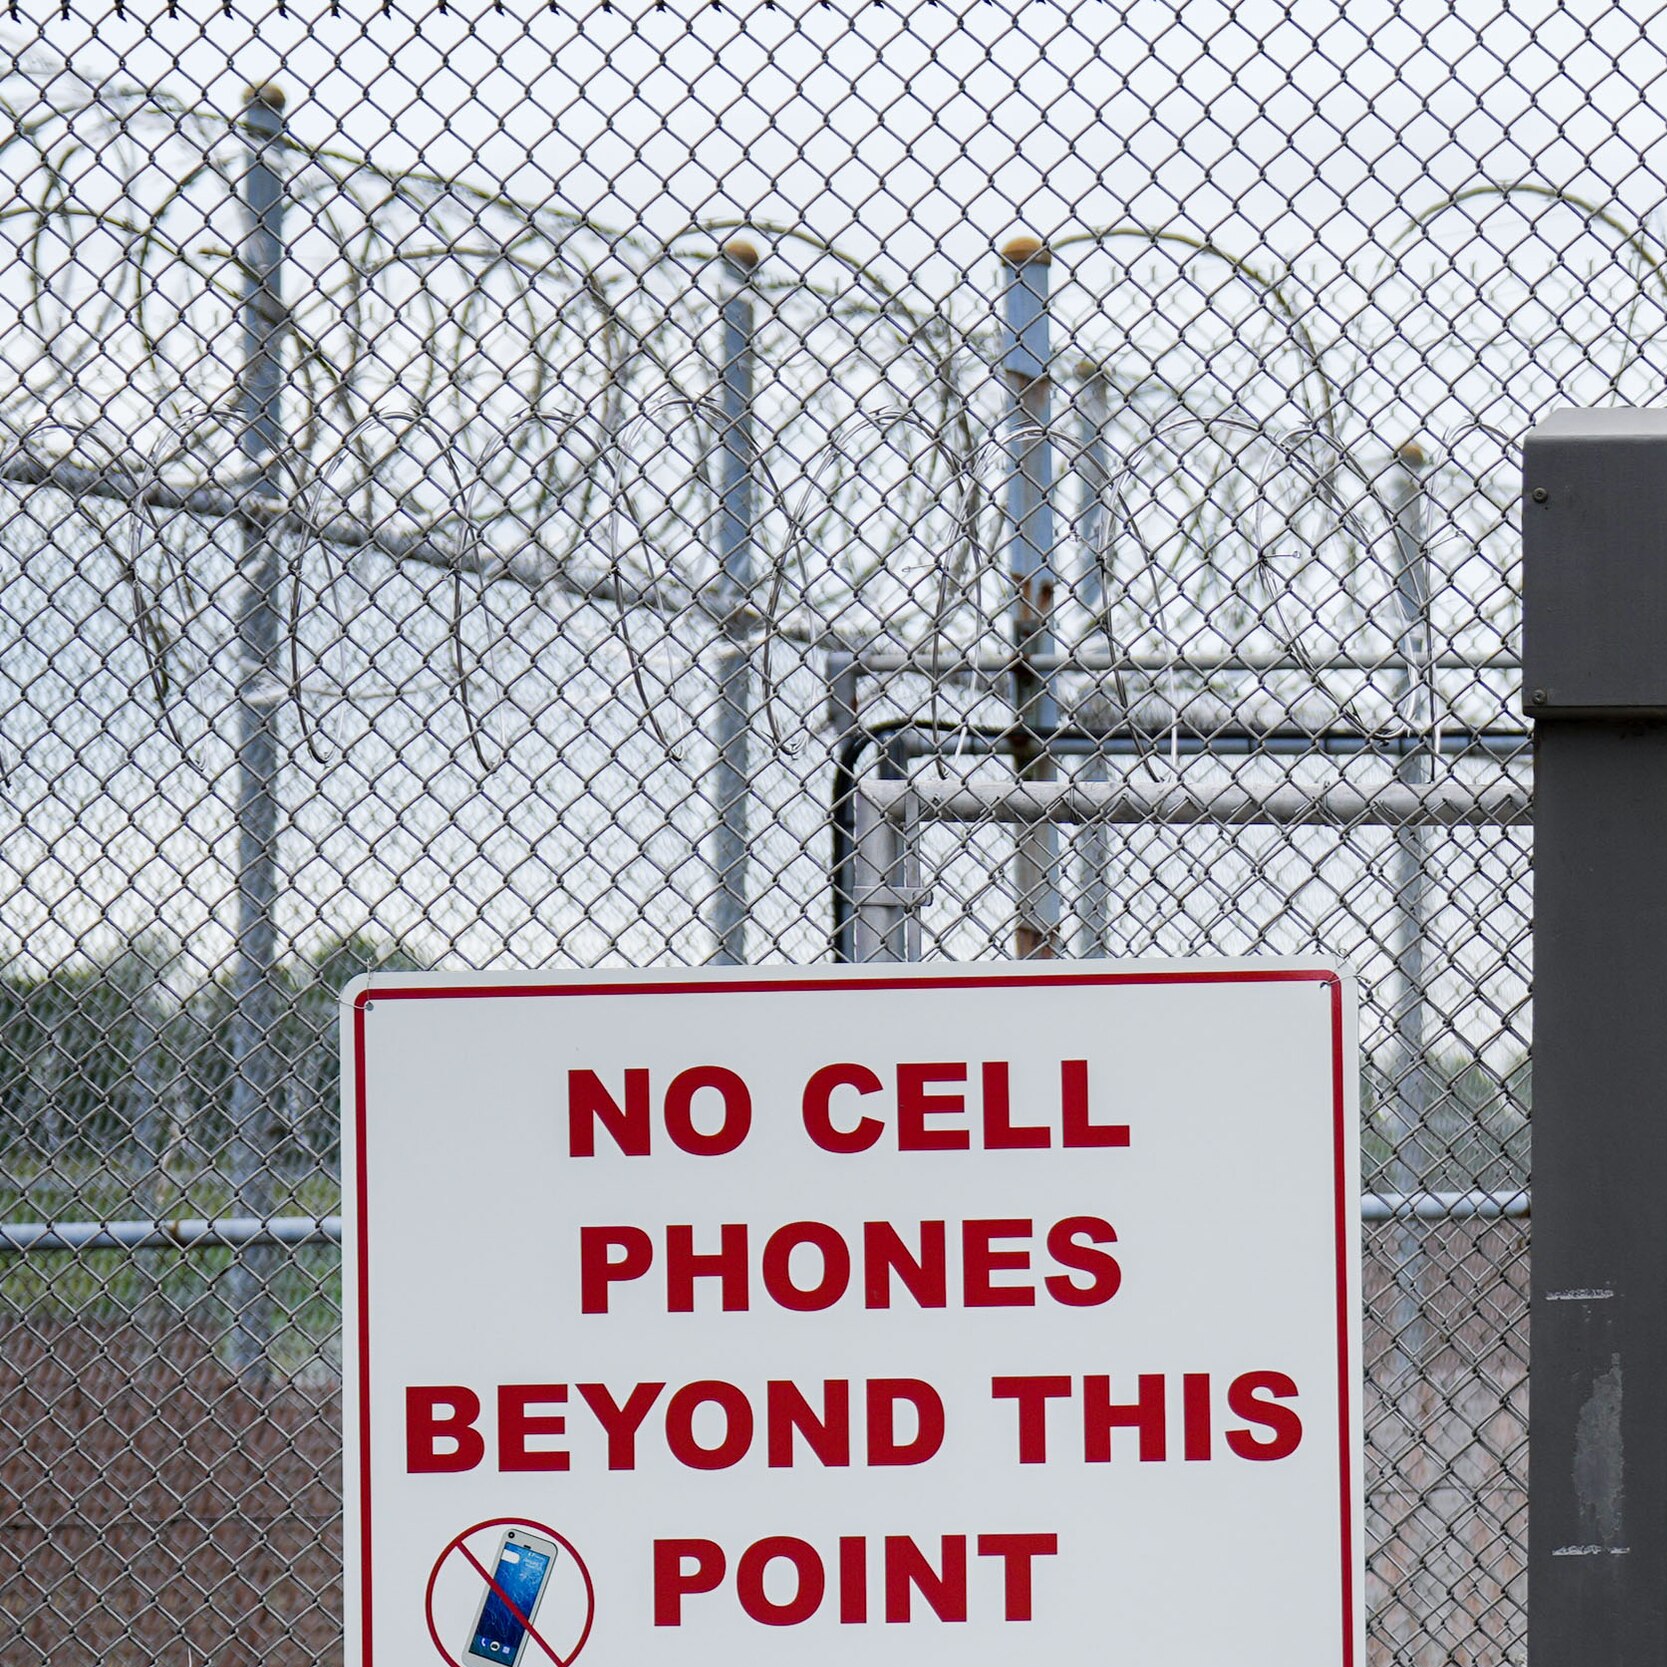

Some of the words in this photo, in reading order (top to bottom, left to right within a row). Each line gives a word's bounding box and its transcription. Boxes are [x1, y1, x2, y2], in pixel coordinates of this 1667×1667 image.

[568, 1066, 752, 1157] NO
[802, 1060, 1130, 1154] CELL
[580, 1216, 1121, 1314] PHONES
[406, 1378, 945, 1474] BEYOND
[992, 1370, 1302, 1464] THIS
[653, 1533, 1058, 1627] POINT
